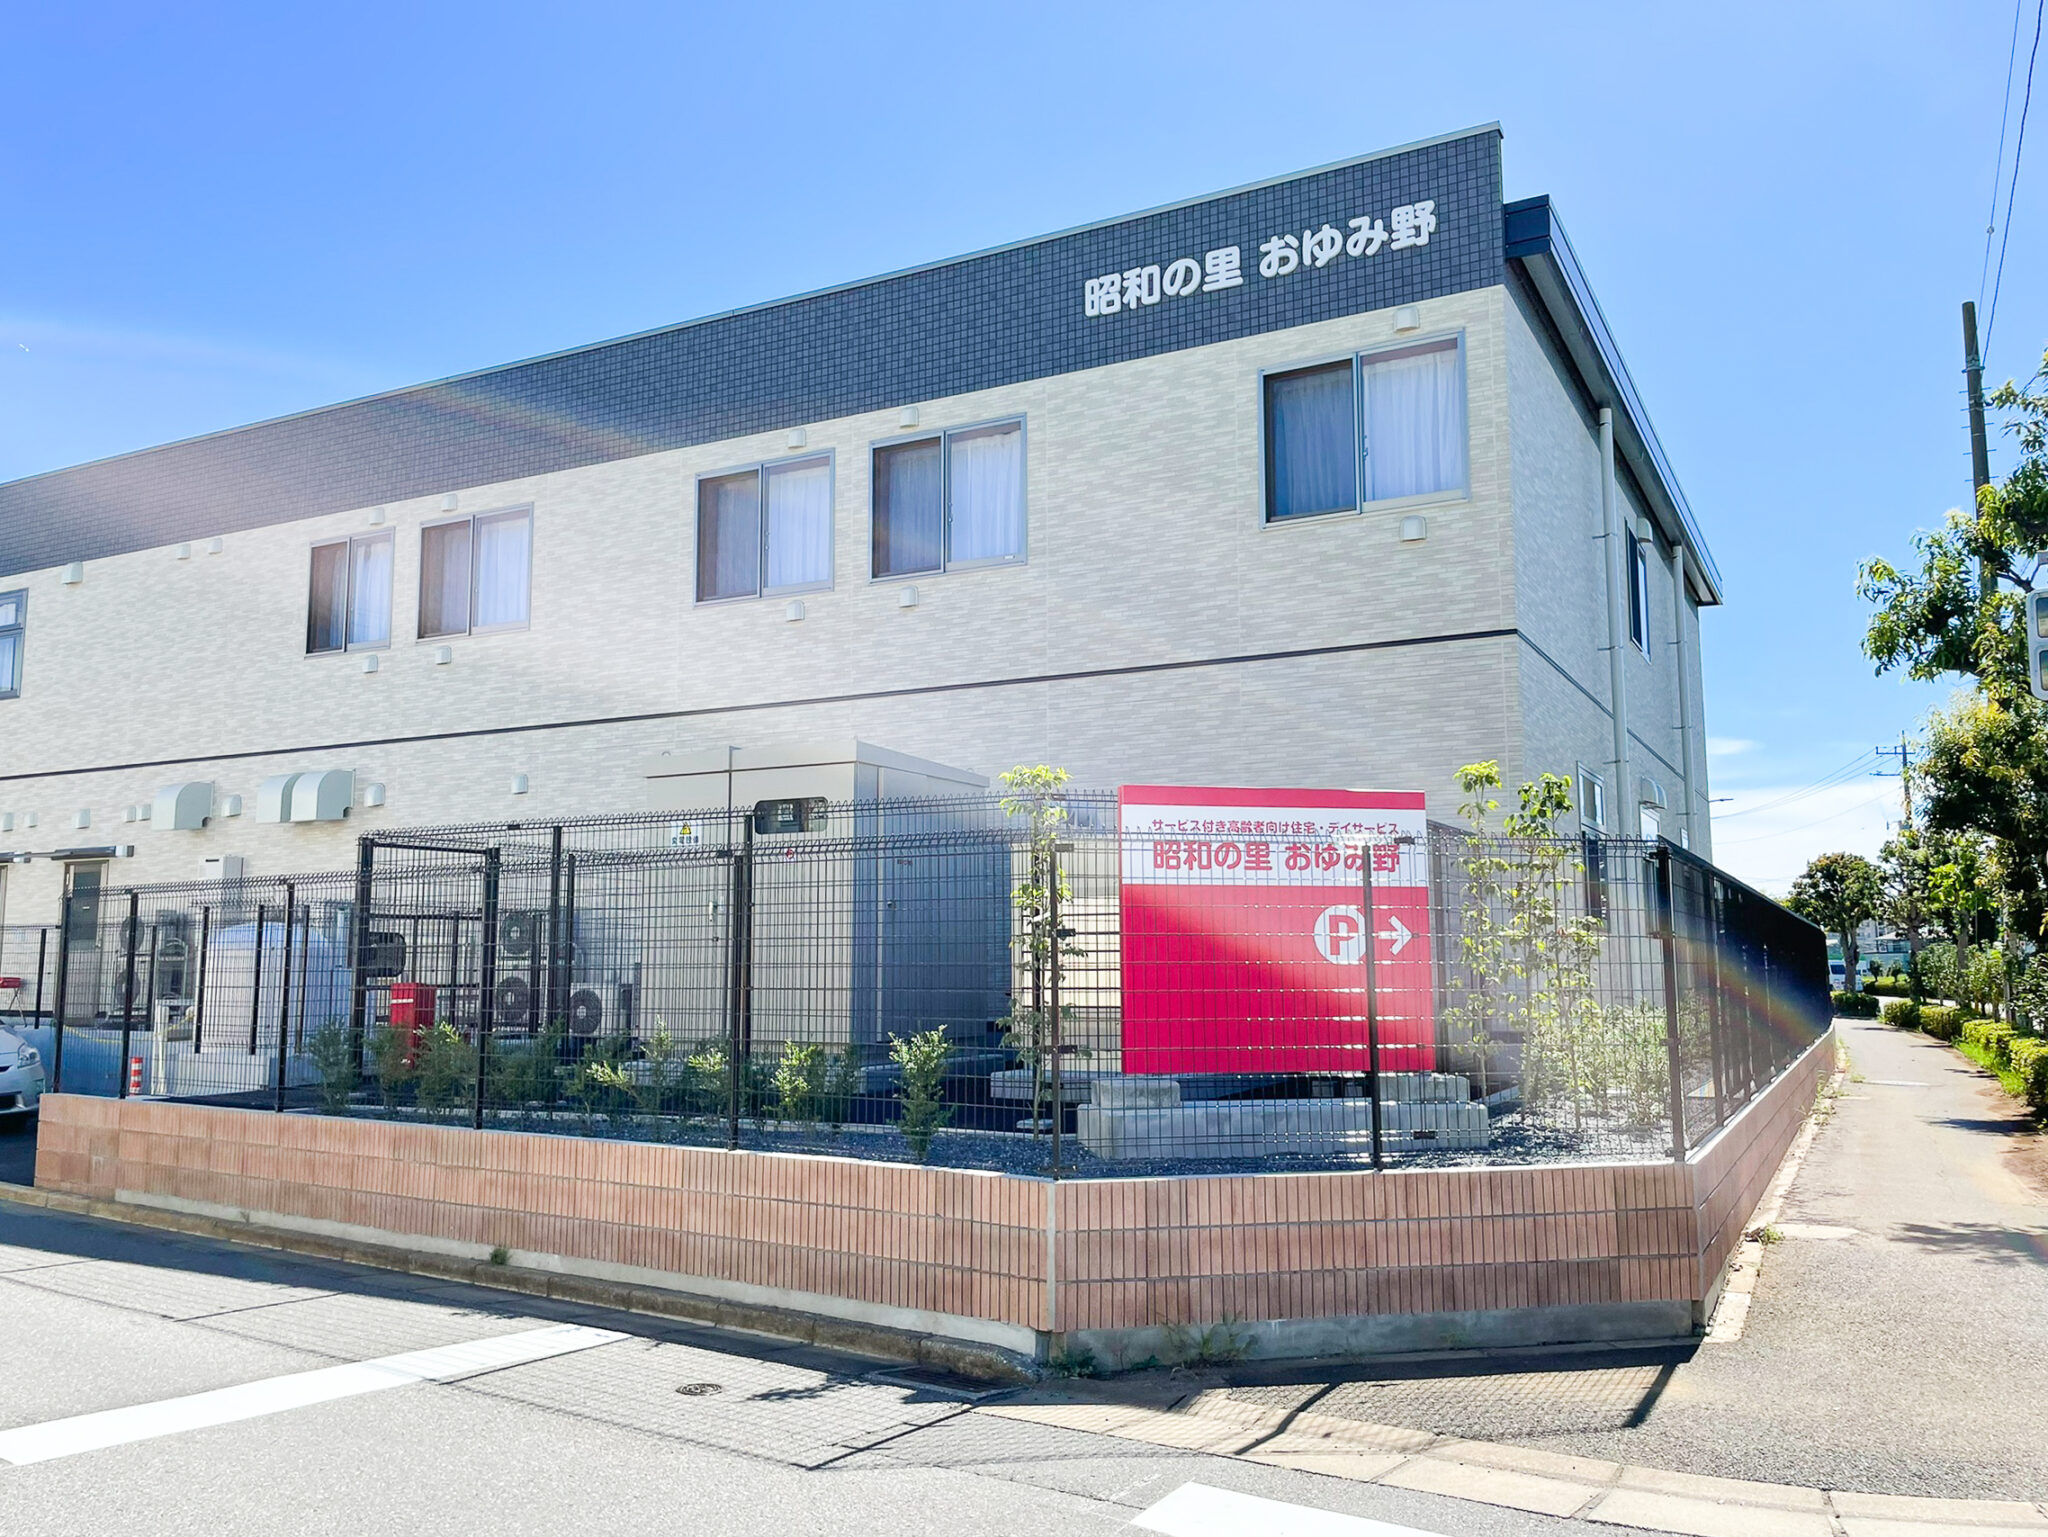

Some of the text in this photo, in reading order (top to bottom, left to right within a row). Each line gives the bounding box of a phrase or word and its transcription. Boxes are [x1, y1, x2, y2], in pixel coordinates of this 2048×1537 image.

[1085, 200, 1436, 317] 昭和の里 おゆみ野
[1153, 841, 1400, 873] 昭和の里 おゆみ野
[1328, 915, 1360, 956] P
